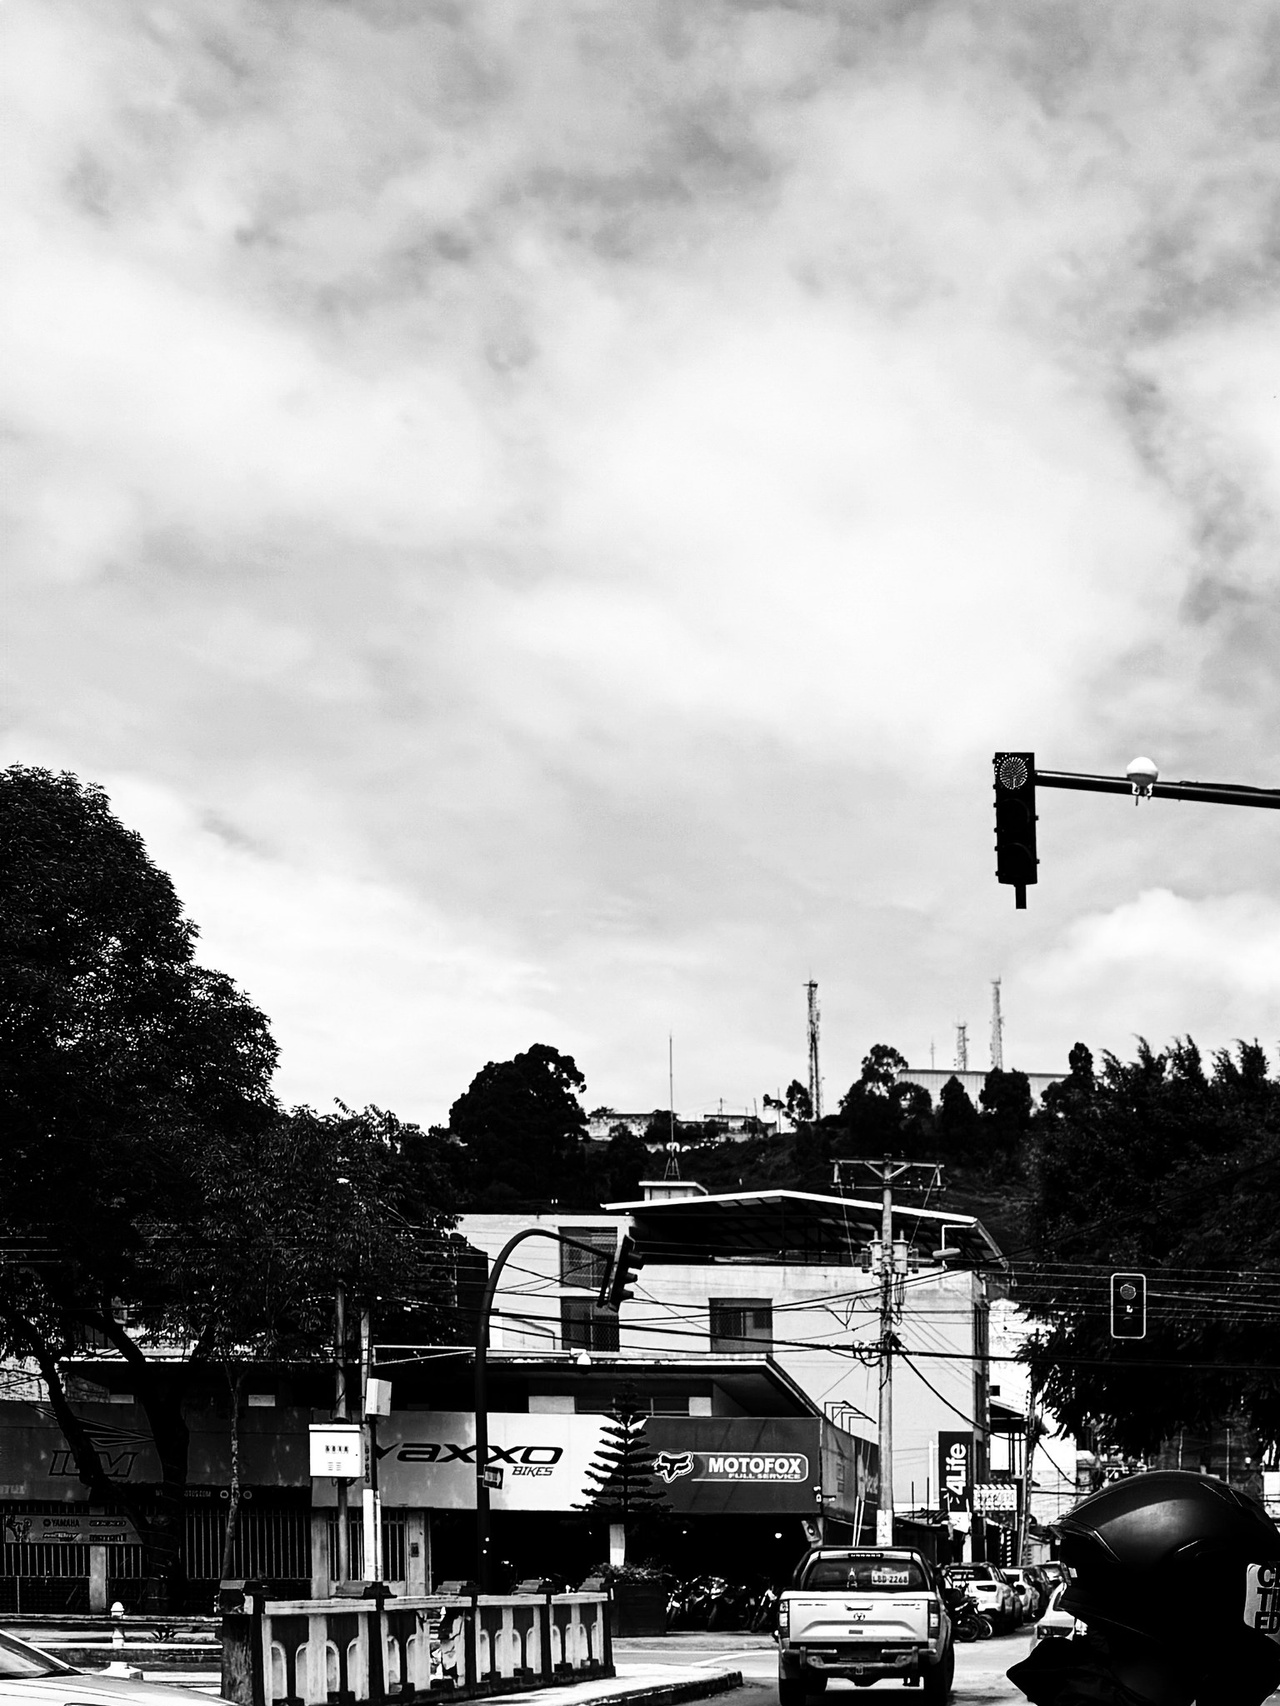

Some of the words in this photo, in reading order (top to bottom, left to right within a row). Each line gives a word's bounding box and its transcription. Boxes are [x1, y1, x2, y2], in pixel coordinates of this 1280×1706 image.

[511, 1465, 554, 1477] BIKES
[708, 1457, 802, 1474] MOTOFOX
[945, 1443, 967, 1496] 4Life
